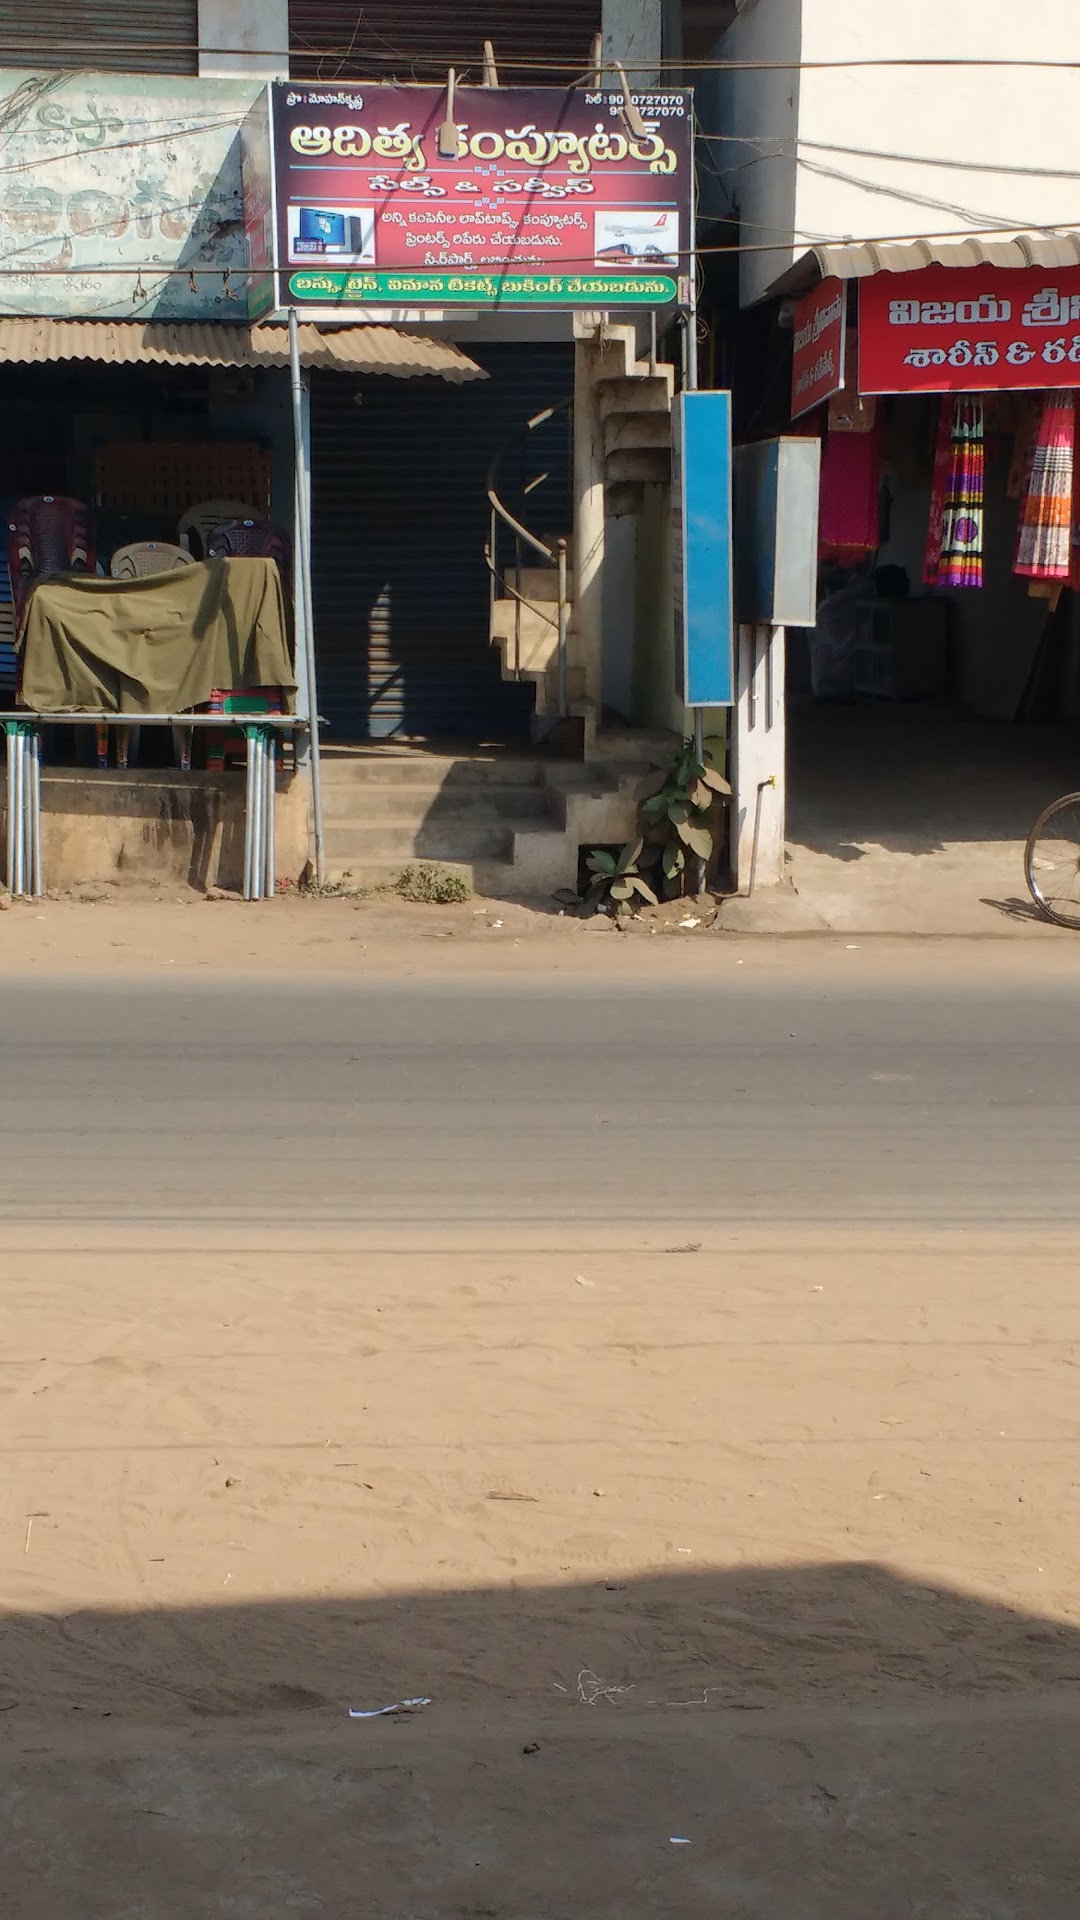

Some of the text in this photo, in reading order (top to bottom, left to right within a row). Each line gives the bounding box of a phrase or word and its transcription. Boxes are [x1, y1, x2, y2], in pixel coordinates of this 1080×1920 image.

[609, 95, 683, 105] 900727070
[609, 107, 685, 117] 9727070
[290, 122, 427, 172] ఆదిత్య
[368, 175, 597, 199] సేల్స్ & సర్వీస్
[381, 211, 407, 228] అన్ని
[405, 230, 450, 249] ప్రింటర్స్
[387, 277, 444, 292] విమాన
[501, 278, 564, 293] బుకింగ్
[888, 293, 1012, 325] విజయ
[903, 339, 1000, 367] శారీస్
[1004, 341, 1036, 365] &
